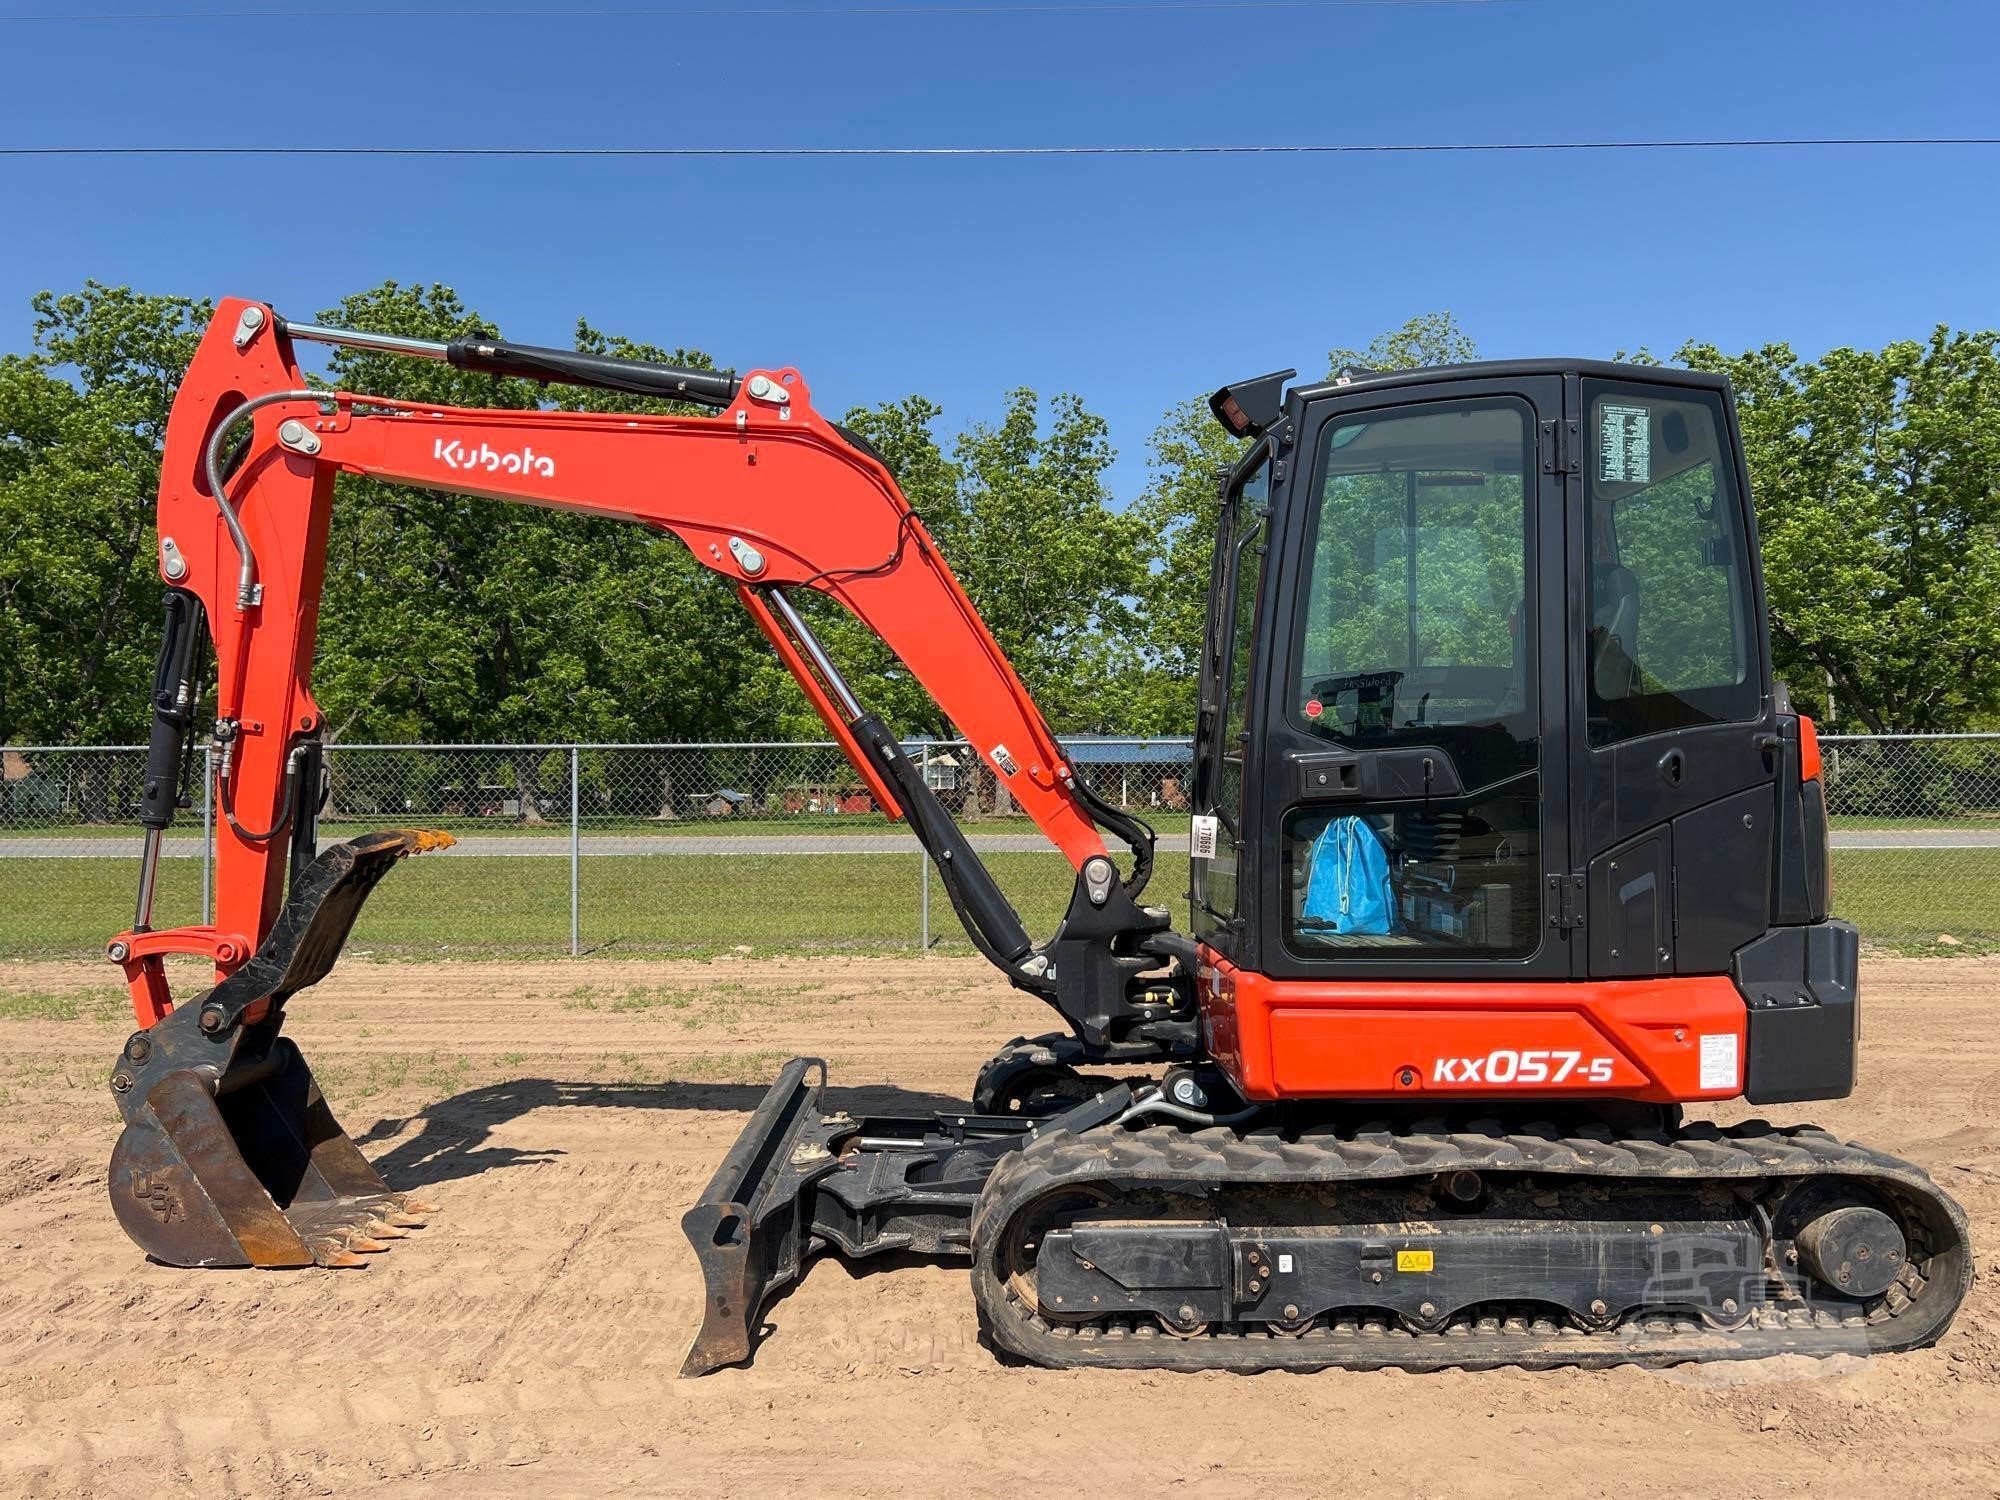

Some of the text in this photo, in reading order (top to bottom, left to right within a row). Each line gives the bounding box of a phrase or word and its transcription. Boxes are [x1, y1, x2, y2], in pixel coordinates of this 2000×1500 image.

[434, 438, 555, 477] Kubota
[1200, 826, 1212, 854] 170686
[1433, 1050, 1614, 1083] KX057-5
[131, 1169, 185, 1224] USA
